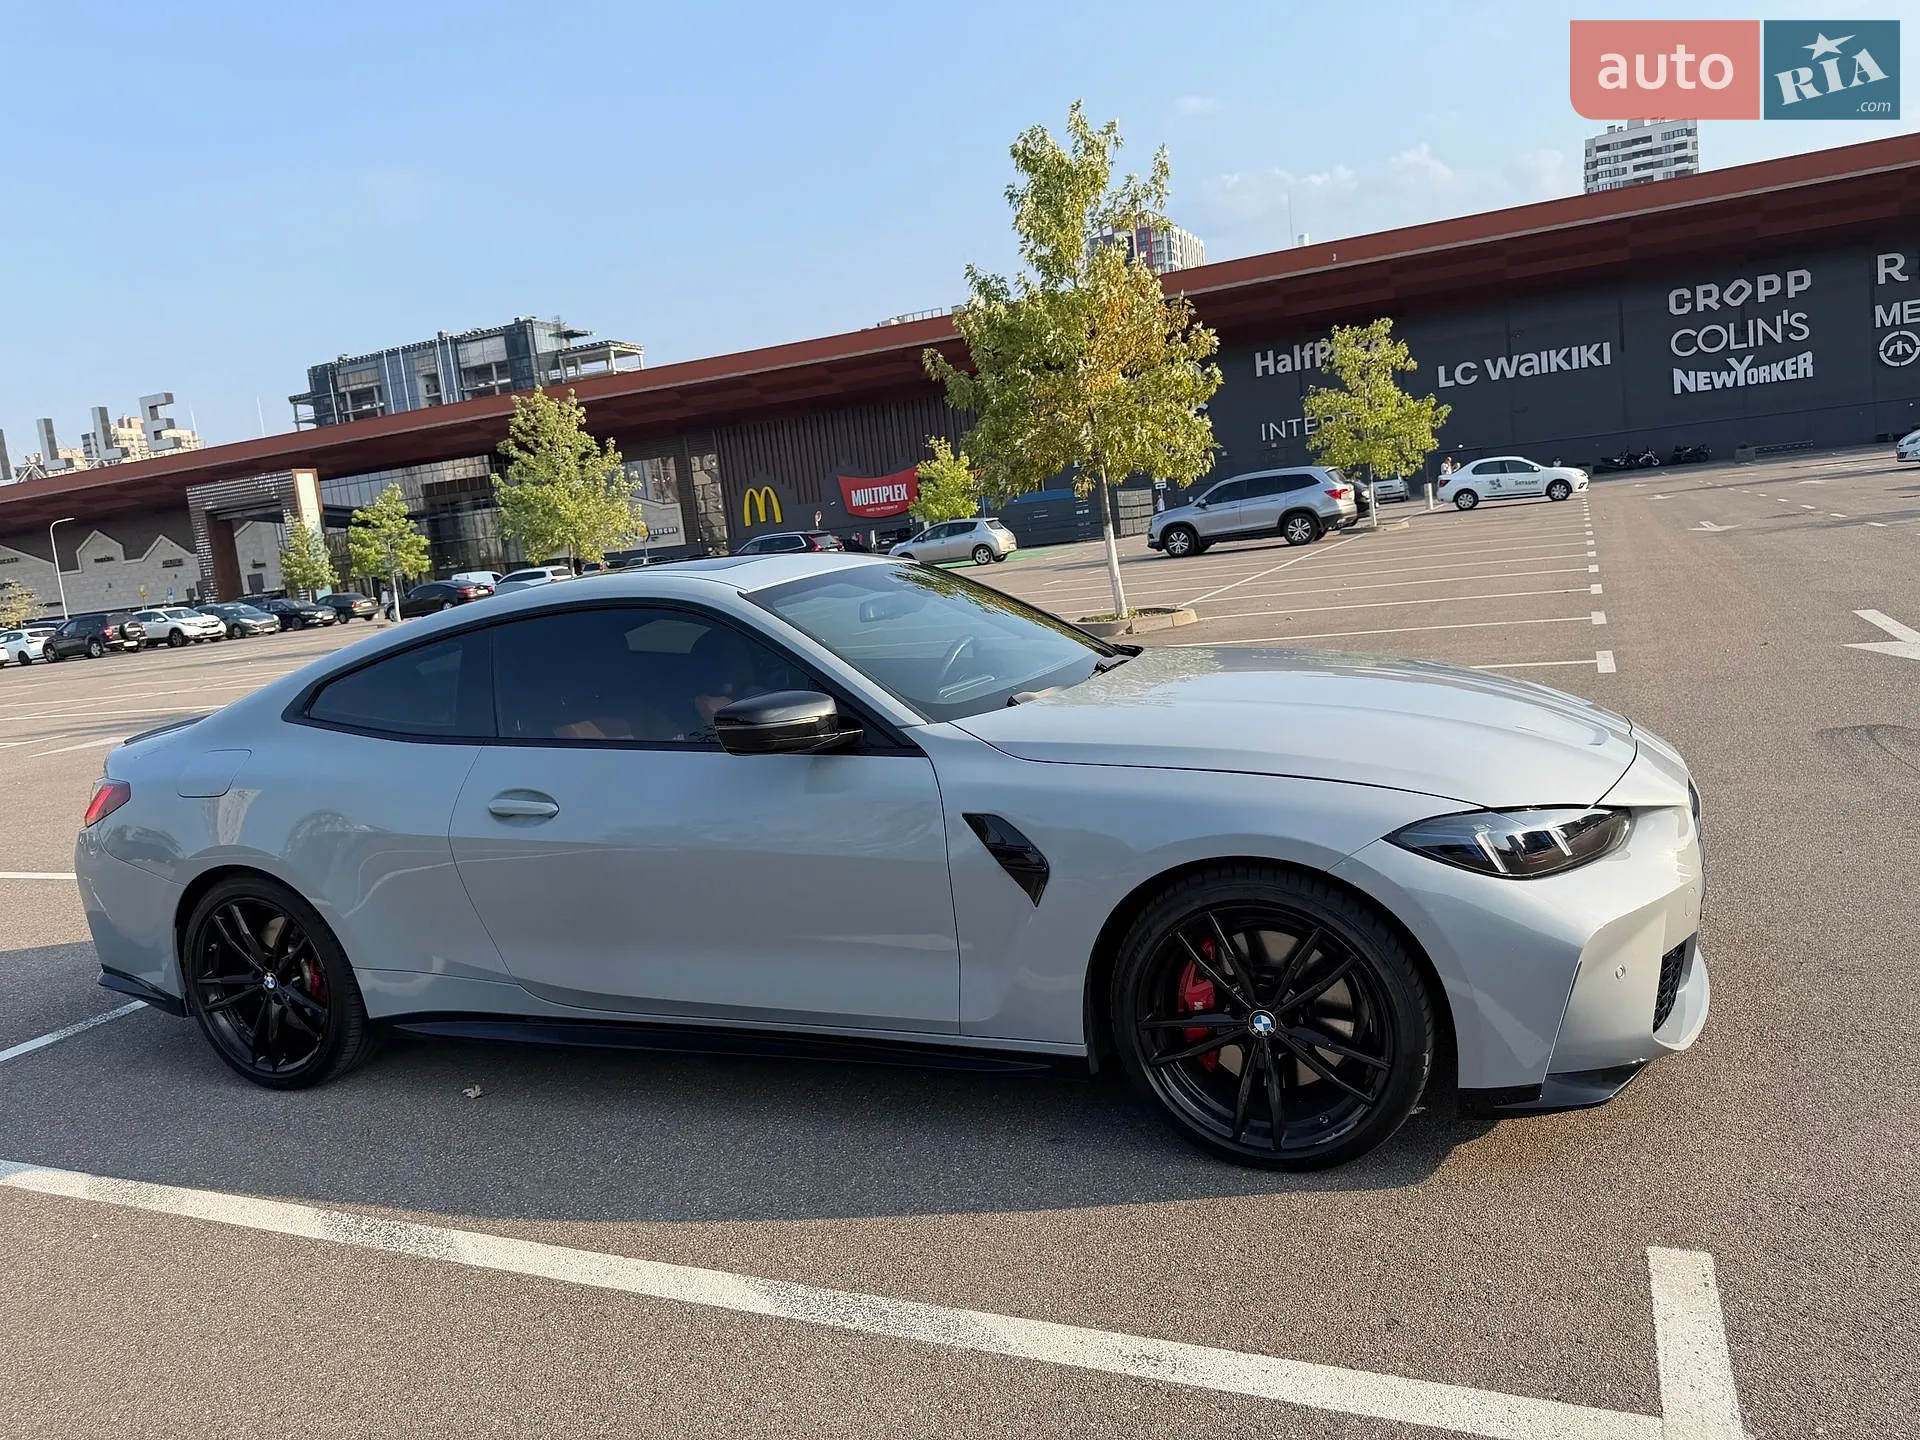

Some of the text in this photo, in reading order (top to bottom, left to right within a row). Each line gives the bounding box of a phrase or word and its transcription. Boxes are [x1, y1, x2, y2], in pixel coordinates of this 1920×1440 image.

[1668, 269, 1812, 316] CROPP
[1670, 309, 1810, 357] COLIN'S
[1438, 360, 1478, 388] LC
[851, 484, 909, 507] MULTIPLEX
